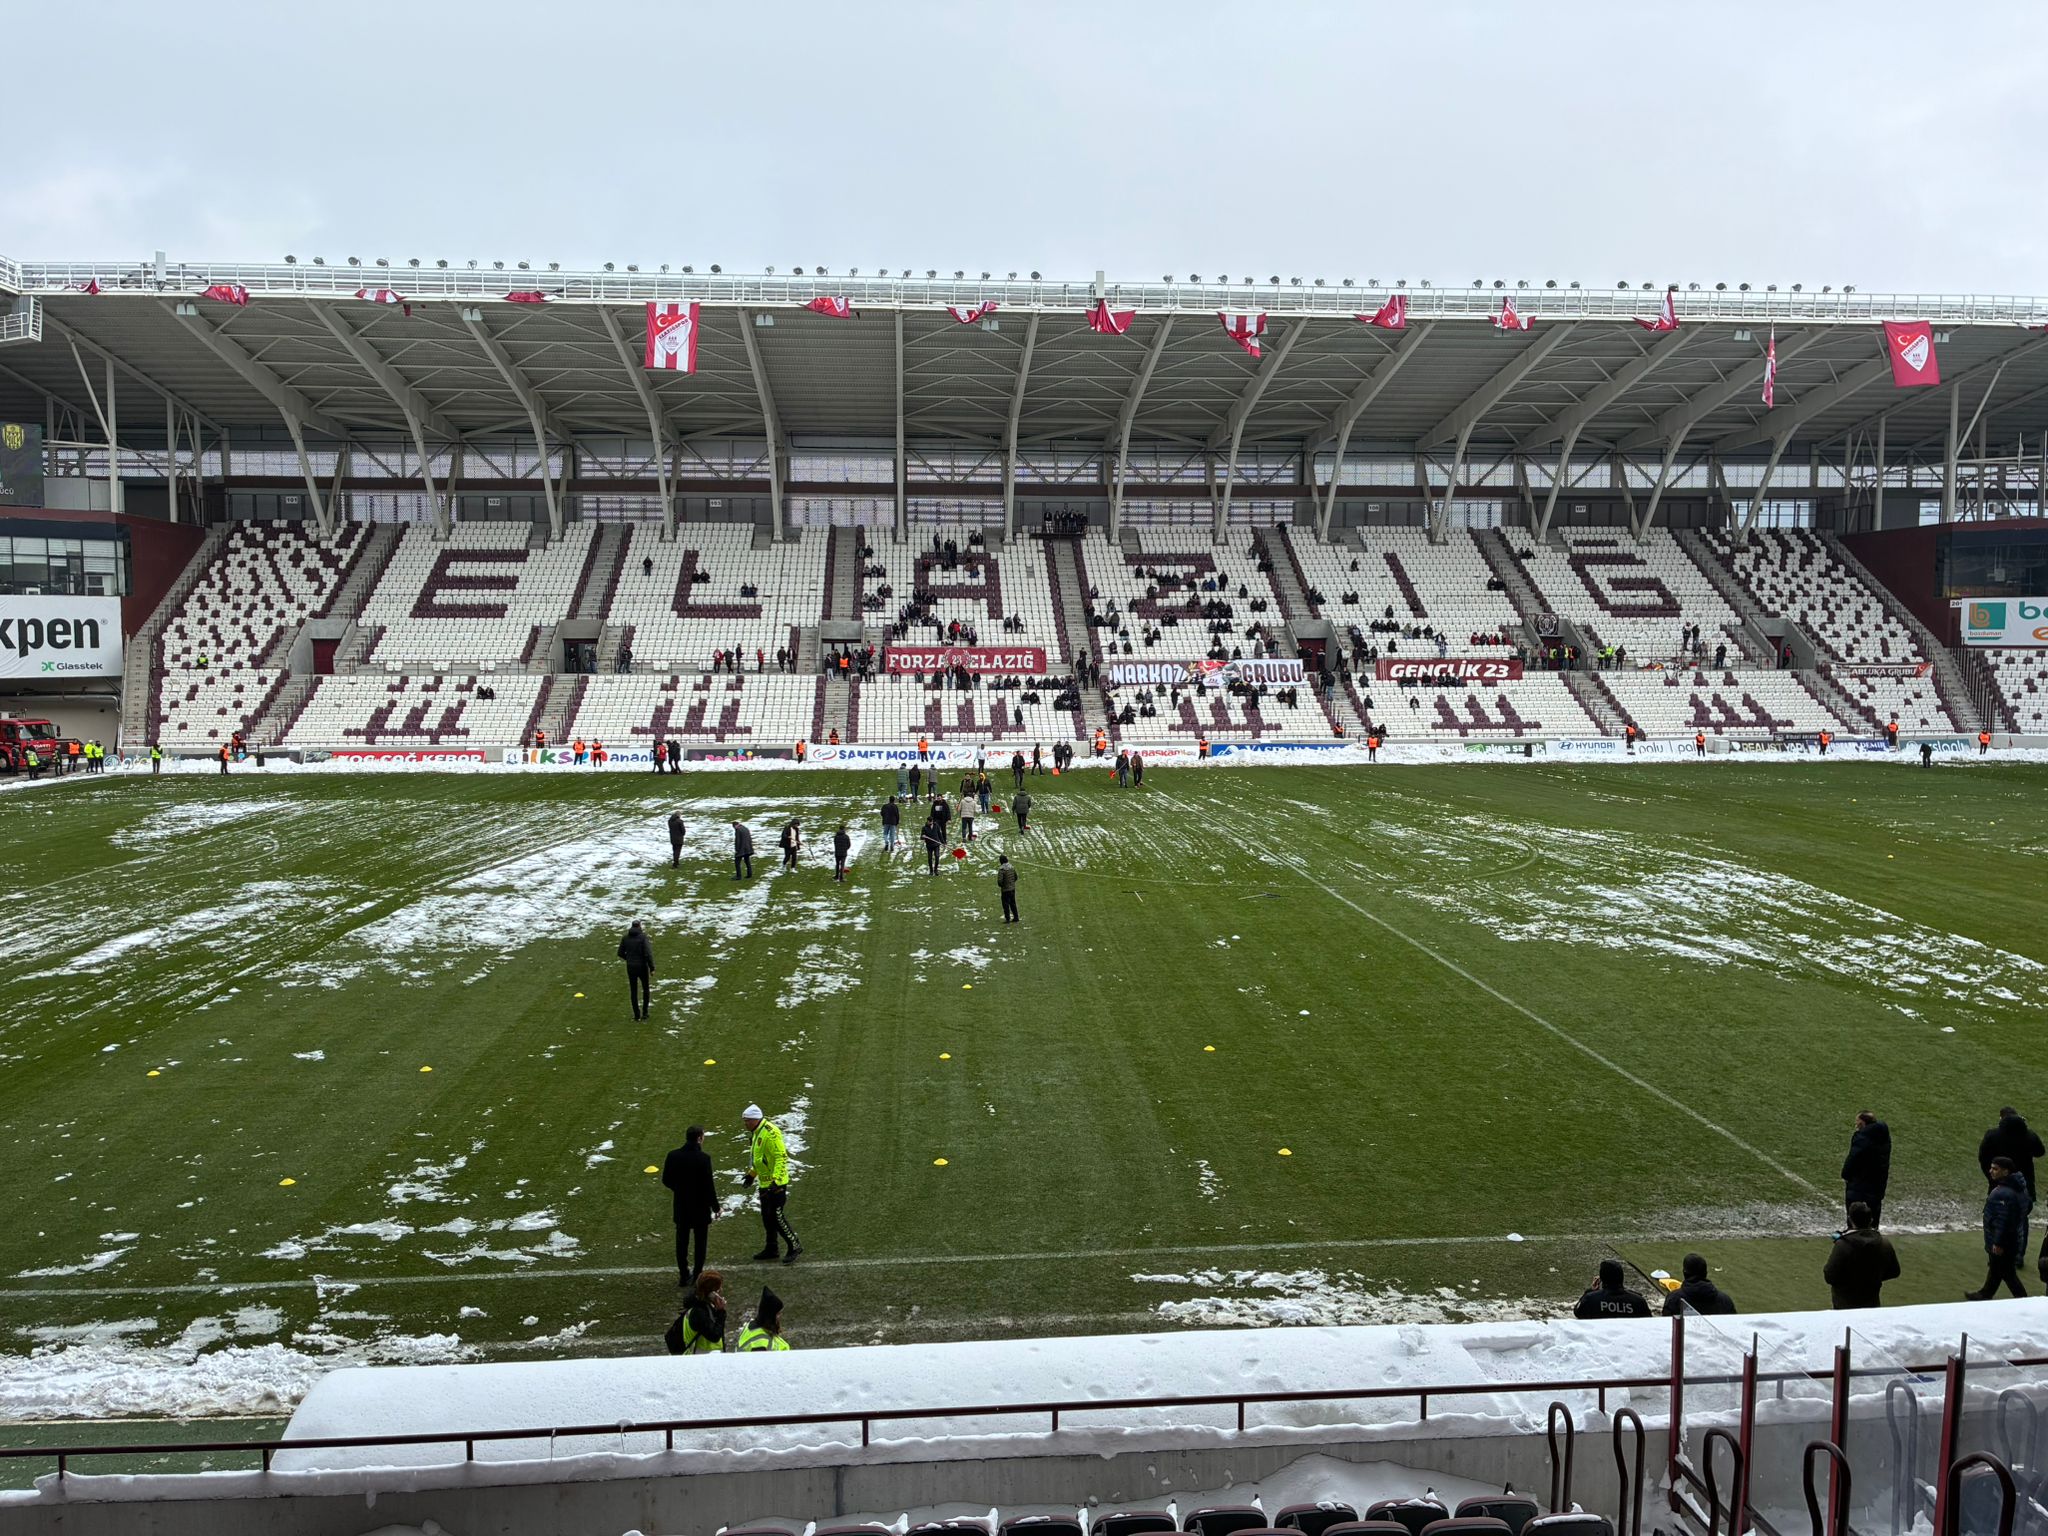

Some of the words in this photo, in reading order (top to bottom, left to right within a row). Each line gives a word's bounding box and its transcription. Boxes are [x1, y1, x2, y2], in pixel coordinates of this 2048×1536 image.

[2018, 601, 2048, 620] b
[56, 662, 103, 670] Glasstek
[889, 654, 948, 669] FORZA
[970, 651, 1034, 669] ELAZIĞ
[1242, 663, 1302, 683] GRUBU
[1484, 664, 1509, 677] 23
